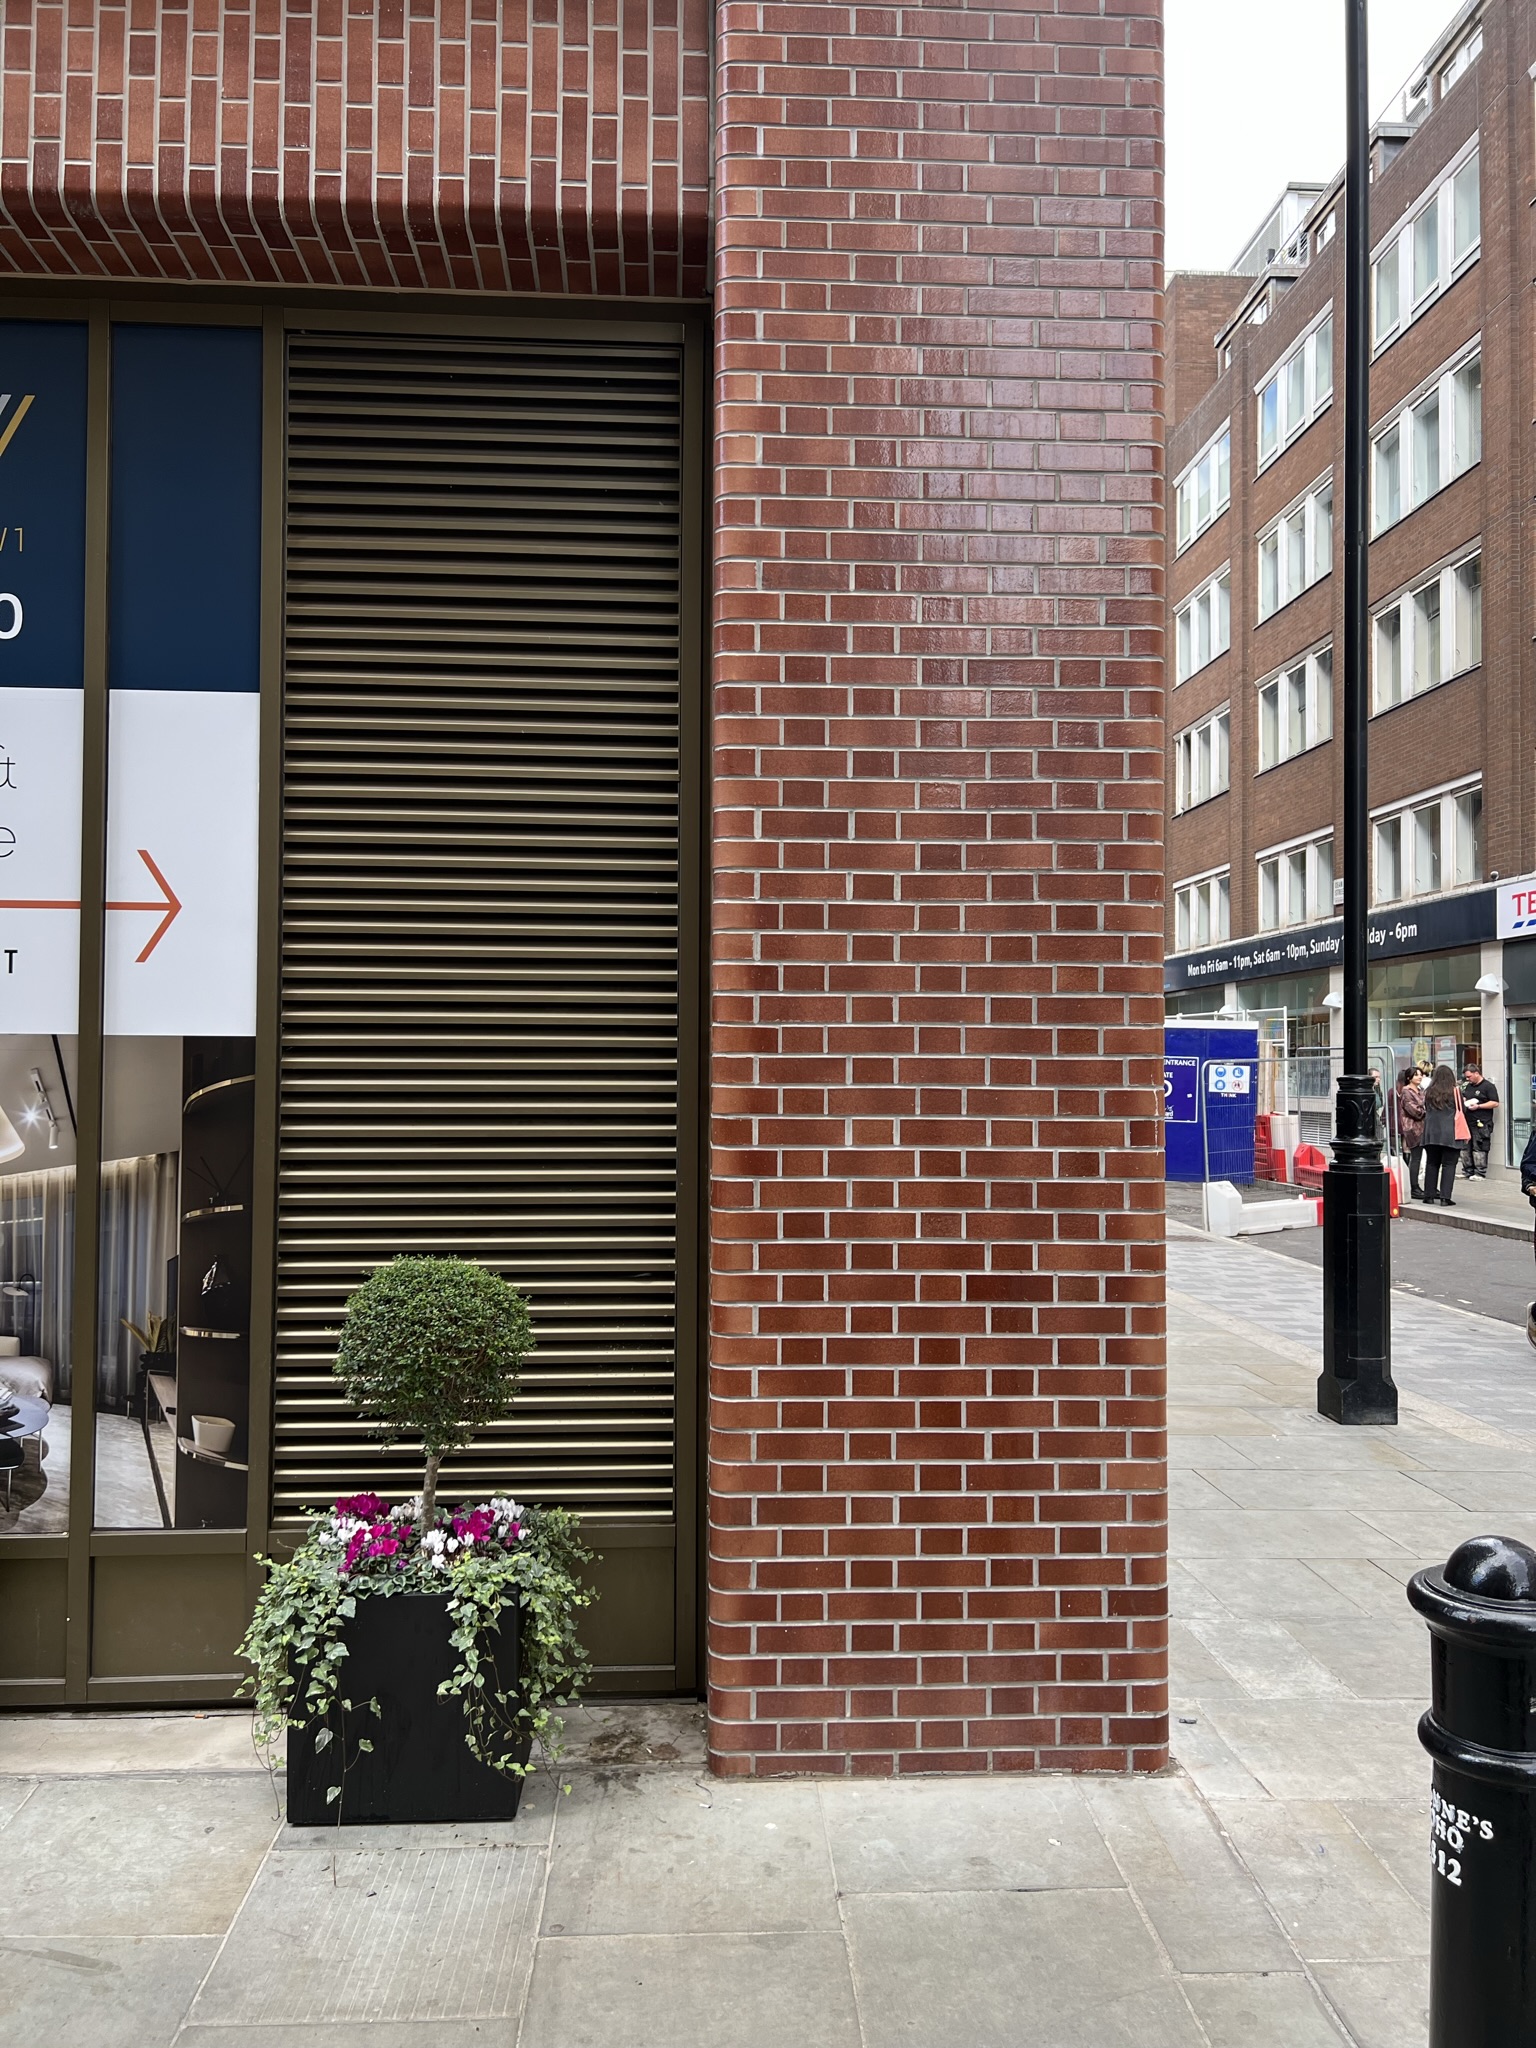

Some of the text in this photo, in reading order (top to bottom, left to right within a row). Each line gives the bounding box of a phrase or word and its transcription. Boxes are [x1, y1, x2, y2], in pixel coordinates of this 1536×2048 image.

[1512, 890, 1536, 916] TE
[1187, 964, 1200, 977] Mon
[1200, 963, 1206, 975] to
[1207, 960, 1215, 973] Fri
[1215, 958, 1229, 972] 6am
[1233, 954, 1253, 971] 11pm,
[1253, 950, 1265, 965] Sat
[1265, 948, 1281, 963] 6am
[1286, 943, 1309, 961] 10pm,
[1310, 935, 1340, 954] Sunday
[1367, 926, 1387, 946] day
[1395, 922, 1418, 943] 6pm
